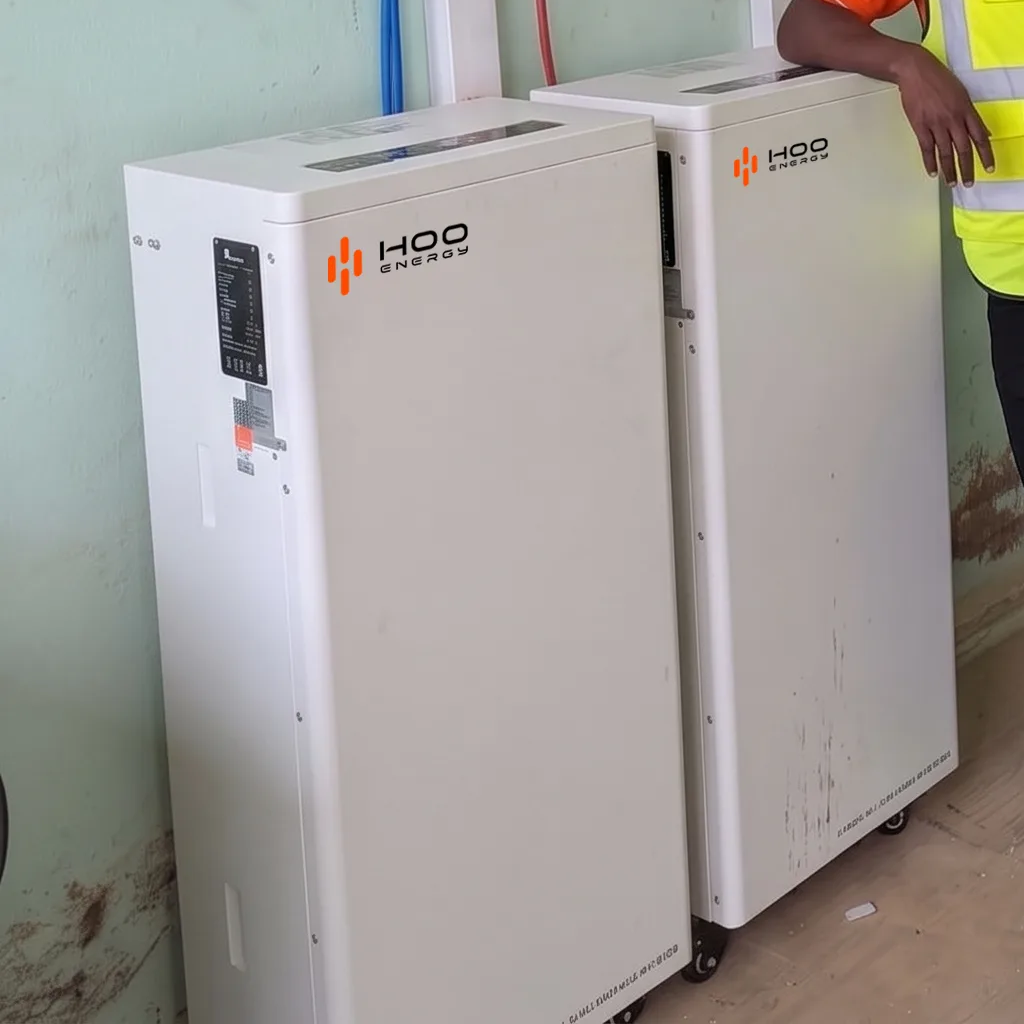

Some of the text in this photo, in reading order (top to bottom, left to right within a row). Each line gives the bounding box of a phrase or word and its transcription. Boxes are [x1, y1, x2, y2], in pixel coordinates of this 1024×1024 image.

[769, 137, 828, 163] HOO
[769, 152, 828, 171] ENERGY
[379, 223, 468, 261] HOO
[380, 245, 468, 273] ENERGY
